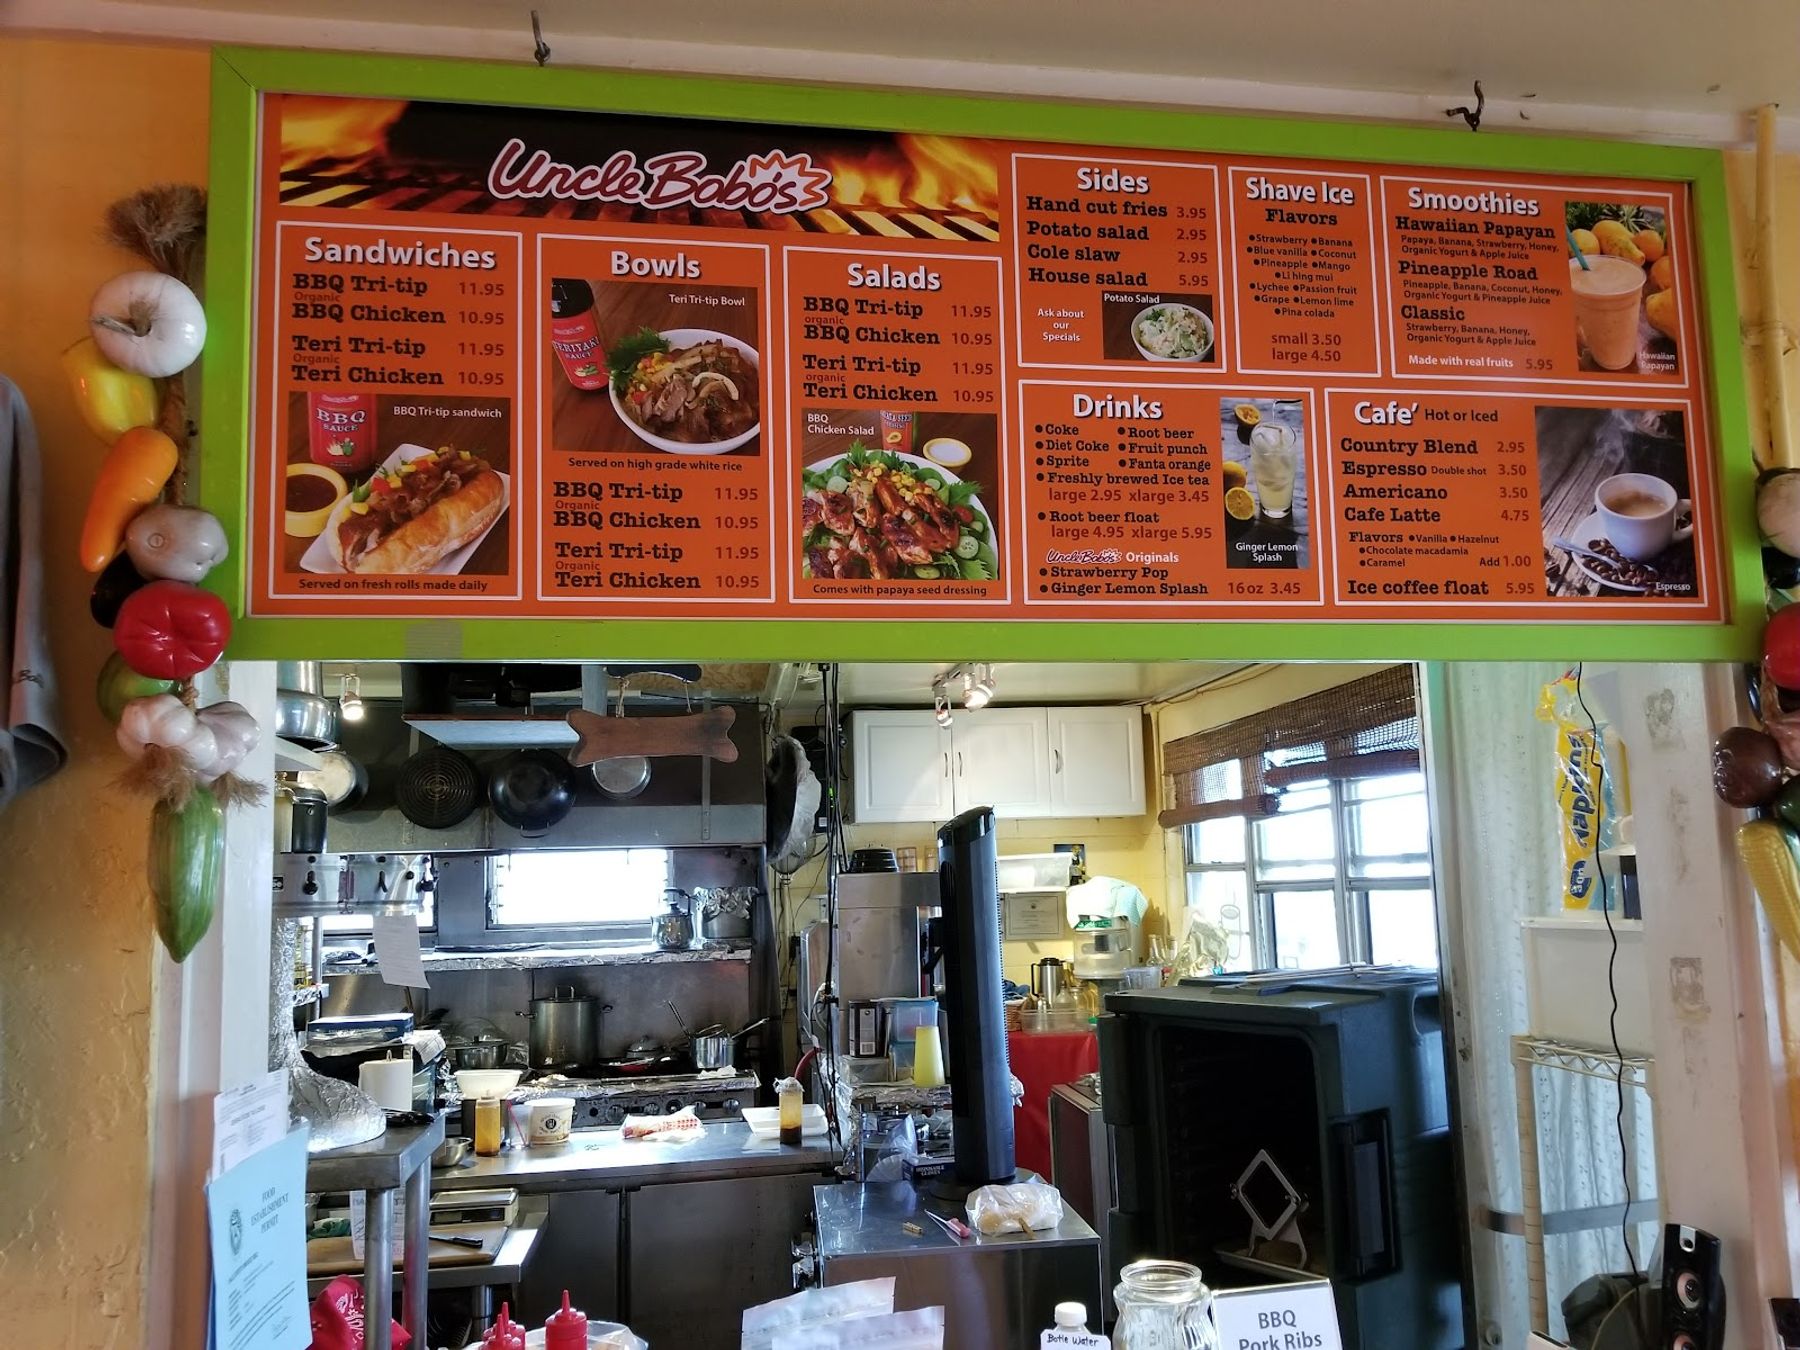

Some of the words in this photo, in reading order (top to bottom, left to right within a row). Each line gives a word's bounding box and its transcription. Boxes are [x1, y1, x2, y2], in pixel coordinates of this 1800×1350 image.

[488, 138, 646, 200] Uncle
[643, 151, 803, 214] Bobo's
[1076, 168, 1150, 193] Sides
[1246, 177, 1317, 203] Shave
[1322, 181, 1354, 205] Ice
[1026, 196, 1080, 213] Hand
[1086, 201, 1117, 215] cut
[1122, 201, 1167, 217] fries
[1176, 207, 1206, 219] 3.95
[1408, 187, 1539, 216] Smoothies
[1265, 209, 1338, 225] Flavors
[1027, 221, 1091, 238] Potato
[1097, 226, 1149, 240] salad
[1176, 228, 1207, 240] 2.95
[1395, 216, 1479, 234] Hawaiian
[1484, 222, 1556, 240] Papayan
[1256, 235, 1307, 246] Strawberry
[1319, 238, 1352, 247] Banana
[304, 237, 497, 270] Sandwiches
[1028, 245, 1069, 259] Cole
[1075, 247, 1120, 261] slaw
[1177, 251, 1207, 263] 2.95
[1402, 246, 1437, 257] Organic
[1439, 248, 1469, 258] Yogurt
[1479, 250, 1505, 260] Apple
[1508, 252, 1529, 260] Juice
[611, 251, 701, 279] Bowls
[1398, 261, 1488, 280] Pineapple
[1493, 266, 1538, 280] Road
[292, 273, 344, 293] BBQ
[351, 275, 428, 296] Tri-tip
[459, 282, 504, 296] 11.95
[847, 263, 941, 291] Salads
[1028, 268, 1090, 283] House
[1096, 271, 1148, 286] salad
[1179, 275, 1208, 286] 5.95
[294, 292, 341, 303] Organic
[669, 294, 688, 304] Teri
[689, 295, 719, 307] Tri-tip
[721, 296, 745, 306] Bowl
[292, 303, 344, 323] BBQ
[351, 305, 446, 323] Chicken
[459, 310, 504, 325] 10.95
[803, 297, 849, 315] BBQ
[855, 299, 923, 319] Tri-tip
[951, 305, 992, 318] 11.95
[1038, 308, 1054, 317] Ask
[1056, 310, 1084, 318] about
[1401, 306, 1465, 320] Classic
[1043, 333, 1080, 341] Specials
[1272, 333, 1307, 344] small
[1312, 334, 1341, 345] 3.50
[292, 336, 342, 352] Teri
[348, 337, 426, 358] Tri-tip
[458, 342, 504, 356] 11.95
[1272, 349, 1307, 363] large
[1311, 350, 1341, 361] 4.50
[1409, 355, 1437, 365] Made
[1439, 356, 1462, 366] with
[1465, 358, 1484, 366] real
[1486, 358, 1513, 367] fruits
[1526, 359, 1553, 370] 5.95
[291, 365, 341, 382] Teri
[348, 367, 444, 385] Chicken
[458, 372, 504, 385] 10.95
[393, 406, 416, 416] BBQ
[418, 408, 449, 418] Tri-tip
[453, 408, 502, 418] sandwich
[1073, 394, 1163, 420] Drinks
[1355, 401, 1418, 425] Cafe'
[1425, 409, 1449, 421] Hot
[1453, 411, 1466, 421] or
[1471, 410, 1498, 422] Iced
[316, 408, 365, 424] BBQ
[807, 414, 829, 423] BBQ
[807, 425, 846, 434] Chicken
[848, 426, 874, 436] Salad
[1046, 424, 1079, 435] Coke
[1128, 427, 1160, 438] Root
[1164, 427, 1194, 439] beer
[1046, 441, 1071, 451] Diet
[1076, 441, 1109, 451] Coke
[1129, 442, 1163, 454] Fruit
[1167, 444, 1208, 456] punch
[1341, 438, 1418, 455] Country
[1424, 440, 1478, 454] Blend
[1497, 441, 1524, 453] 2.95
[569, 457, 607, 467] Served
[611, 459, 624, 468] on
[628, 459, 652, 470] high
[655, 460, 687, 470] grade
[689, 461, 720, 470] white
[723, 462, 742, 470] rice
[1342, 461, 1427, 478] Espresso
[1431, 466, 1464, 475] Double
[1467, 467, 1486, 475] shot
[1498, 464, 1526, 475] 3.50
[1047, 473, 1103, 485] Freshly
[1107, 473, 1158, 485] brewed
[1162, 475, 1184, 485] Ice
[1187, 476, 1209, 485] tea
[554, 482, 603, 501] BBQ
[609, 483, 683, 502] Tri-tip
[714, 488, 758, 501] 11.95
[1049, 488, 1086, 504] large
[1091, 490, 1121, 501] 2.95
[1129, 489, 1174, 505] xlarge
[1180, 490, 1209, 502] 3.45
[1344, 507, 1385, 522] Cafe
[1390, 508, 1440, 522] Latte
[1501, 510, 1529, 521] 4.75
[1349, 532, 1403, 542] Flavors
[1416, 535, 1447, 543] Vanilla
[1458, 535, 1499, 543] Hazelnut
[1051, 567, 1137, 580] Strawberry
[1141, 567, 1169, 580] Pop
[299, 579, 341, 589] Served
[344, 581, 358, 589] on
[362, 580, 391, 589] fresh
[394, 580, 419, 590] rolls
[423, 581, 456, 590] made
[459, 580, 488, 592] daily
[813, 584, 848, 594] Comes
[851, 585, 874, 594] with
[876, 586, 914, 597] papaya
[917, 585, 941, 594] seed
[944, 585, 987, 597] dressing
[1051, 583, 1101, 596] Ginger
[1105, 583, 1155, 594] Lemon
[1160, 583, 1208, 596] Splash
[1228, 582, 1245, 594] 16
[1247, 585, 1263, 594] oz
[1270, 582, 1300, 594] 3.45
[1348, 580, 1377, 594] Ice
[1383, 581, 1438, 595] coffee
[1444, 581, 1489, 595] float
[1507, 583, 1534, 594] 5.95
[1656, 582, 1690, 591] Espresso
[1258, 1310, 1296, 1329] BBQ
[1239, 1335, 1279, 1350] Pork
[1284, 1331, 1322, 1350] Ribs
